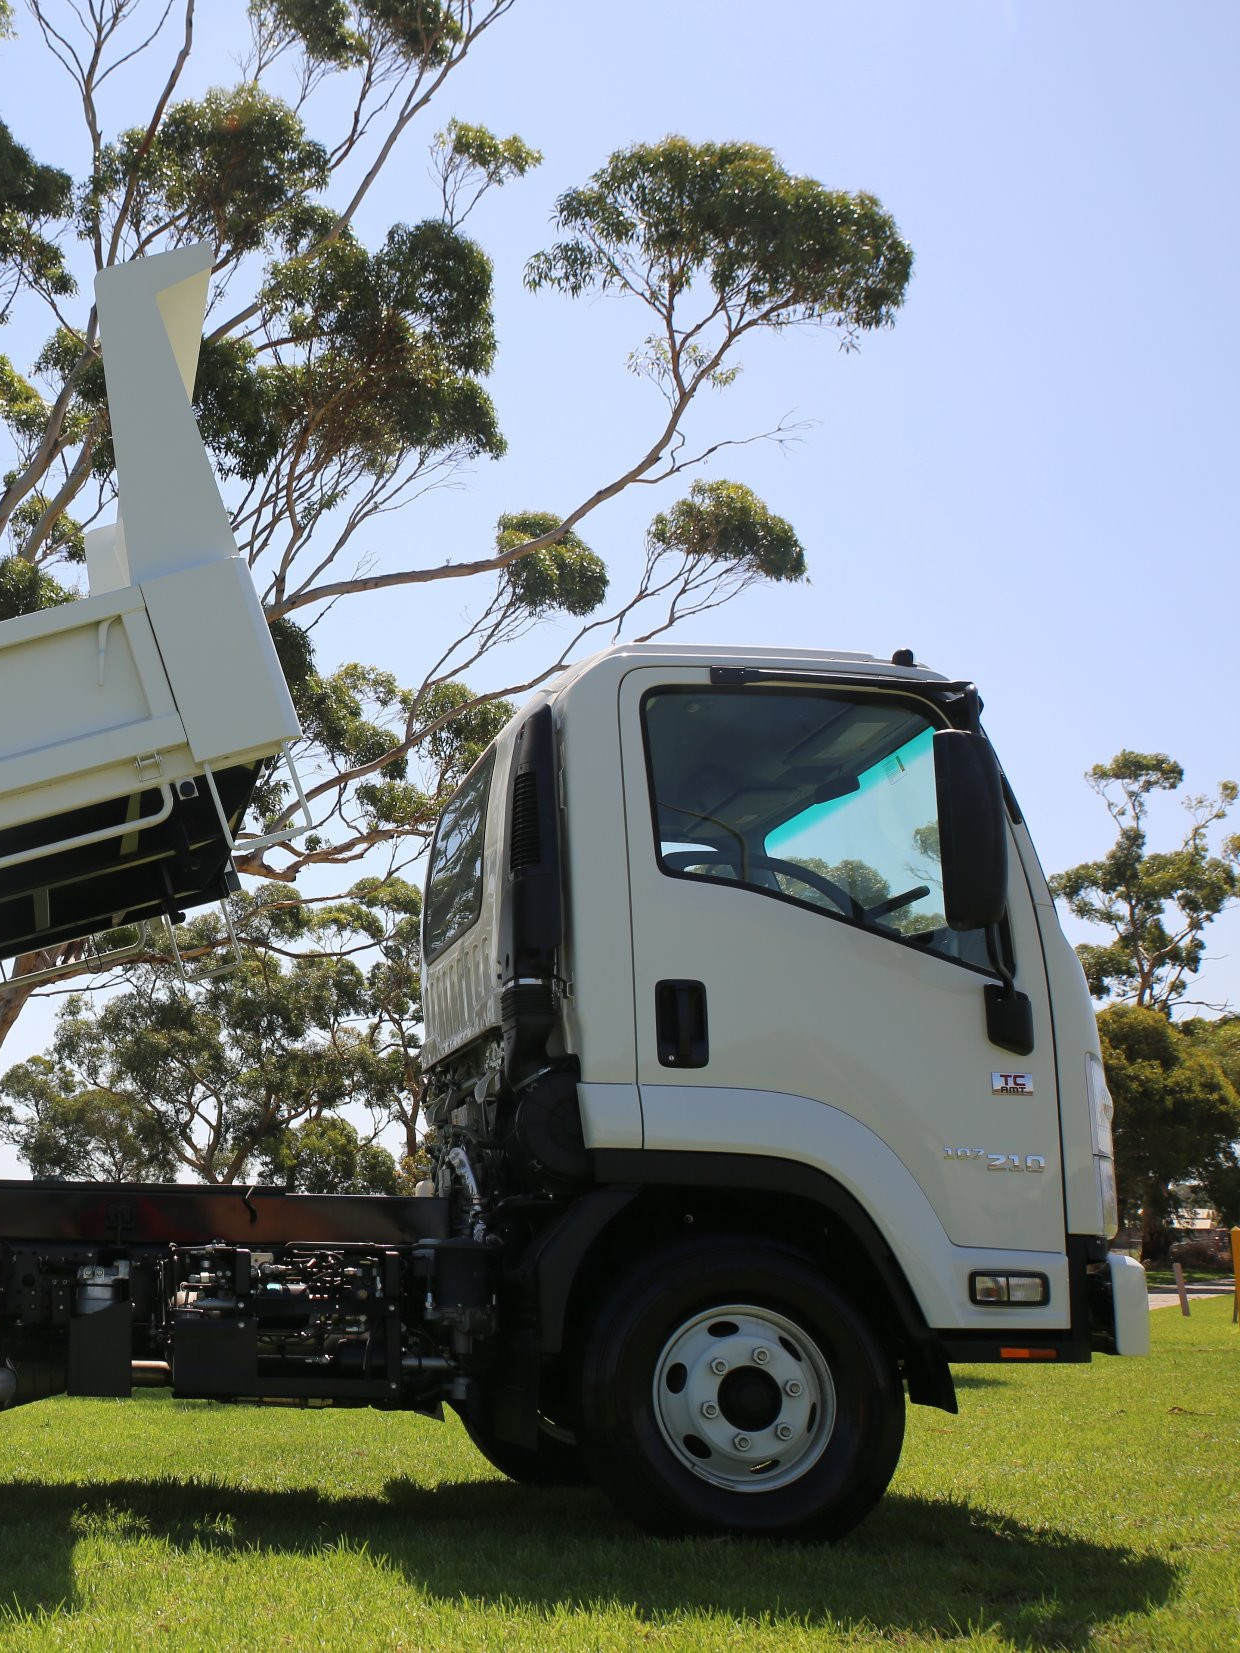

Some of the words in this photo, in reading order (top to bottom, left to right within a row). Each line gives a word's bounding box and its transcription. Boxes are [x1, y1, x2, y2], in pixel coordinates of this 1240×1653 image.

[1000, 1074, 1026, 1087] TC
[1000, 1086, 1026, 1094] AMT
[986, 1153, 1046, 1173] 210
